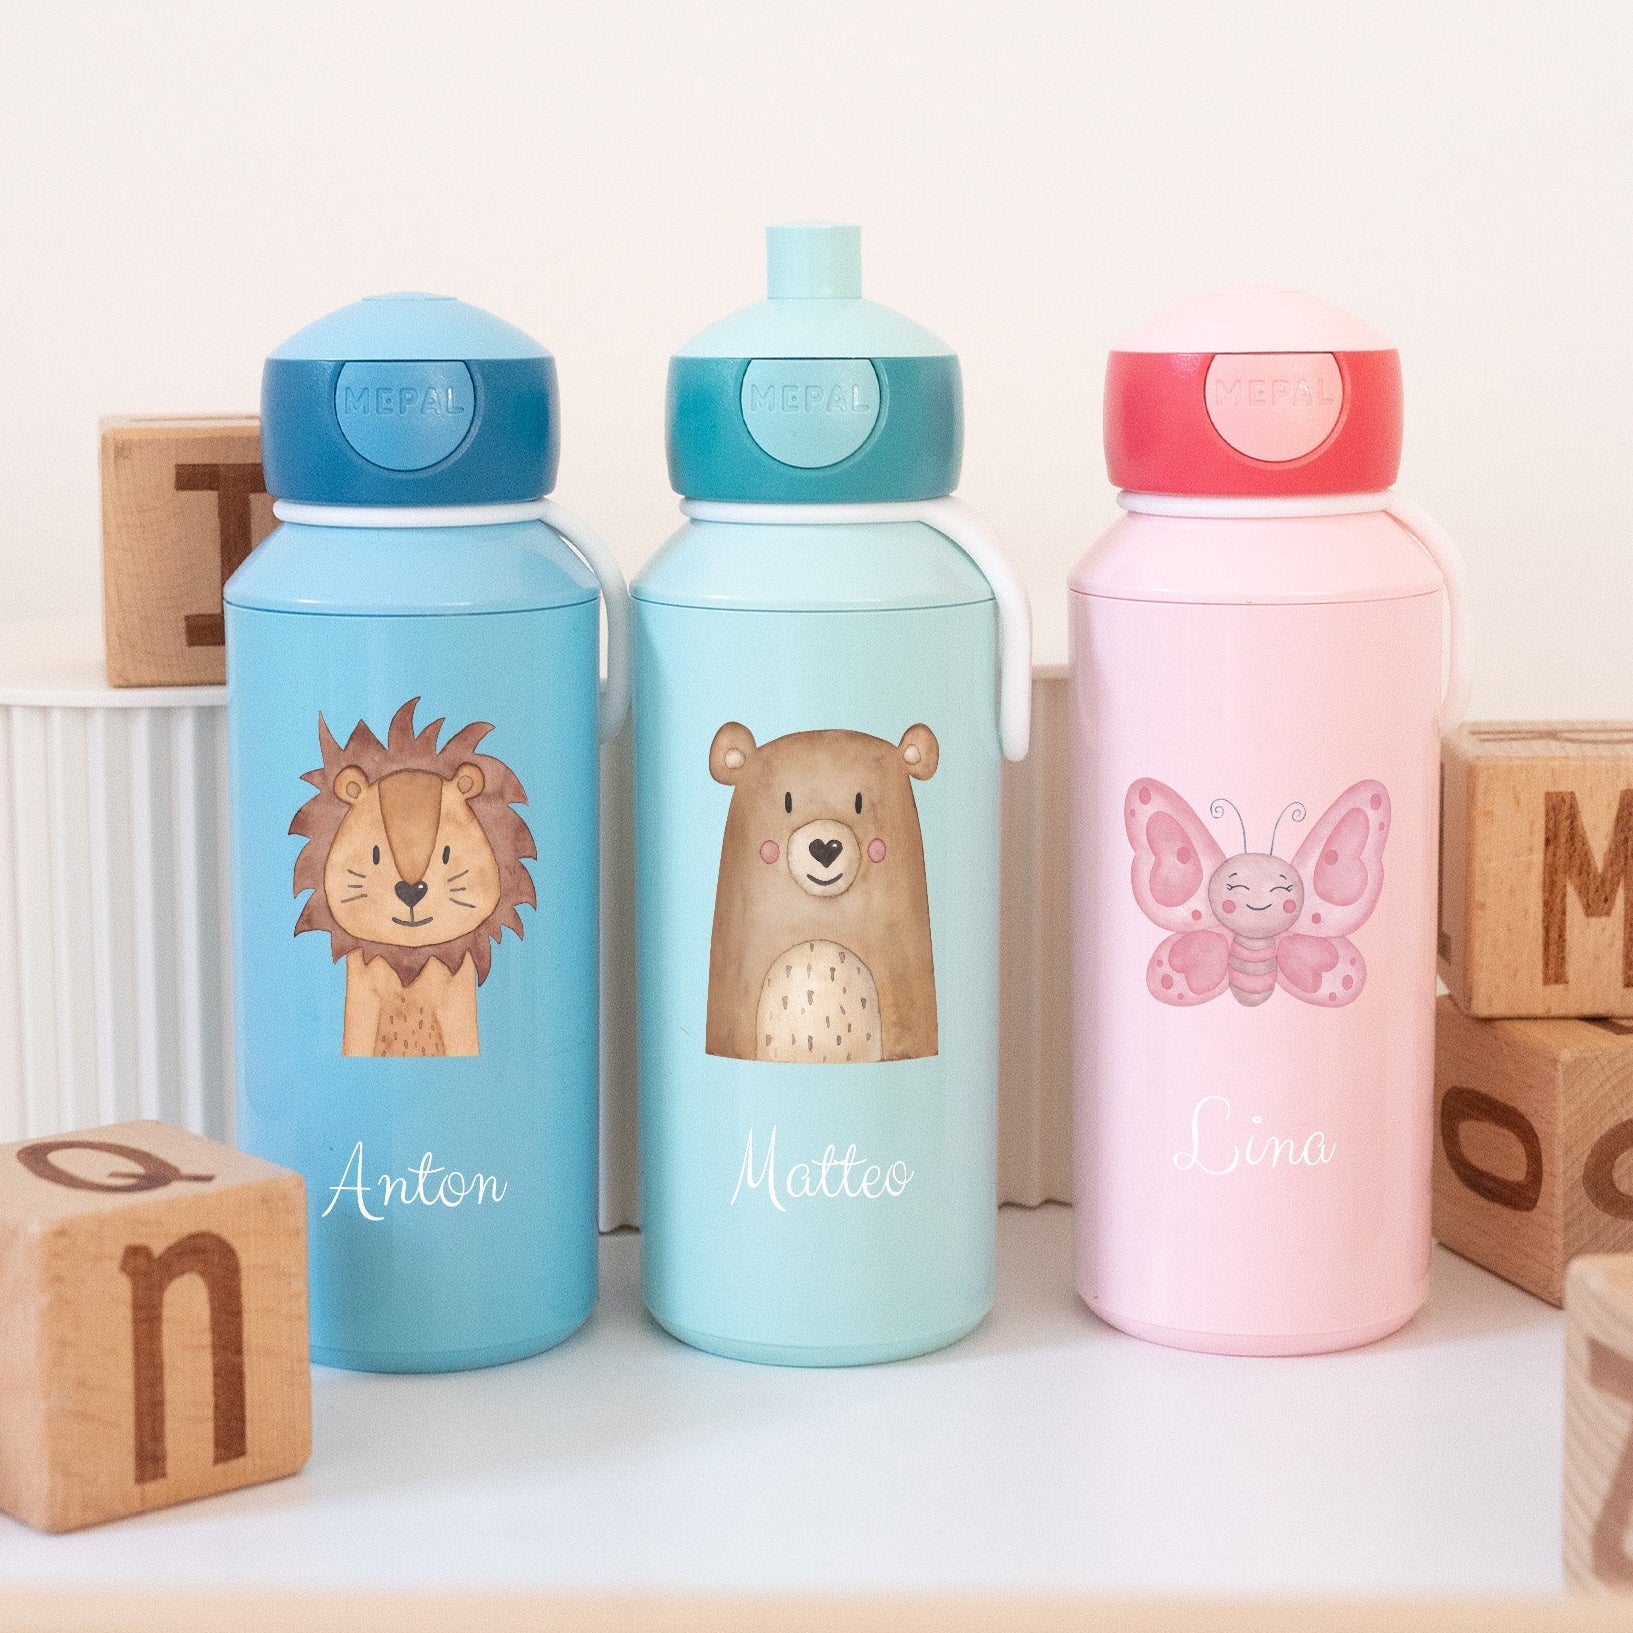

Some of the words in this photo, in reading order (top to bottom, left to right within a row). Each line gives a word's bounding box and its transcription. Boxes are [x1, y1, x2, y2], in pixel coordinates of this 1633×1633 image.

[344, 386, 465, 417] MEPAL
[750, 384, 870, 414] MEPAL
[1217, 379, 1334, 406] MEPAL
[730, 1125, 915, 1213] Matteo
[1172, 1094, 1337, 1176] Lina
[321, 1140, 508, 1221] Anton
[119, 1230, 247, 1485] n
